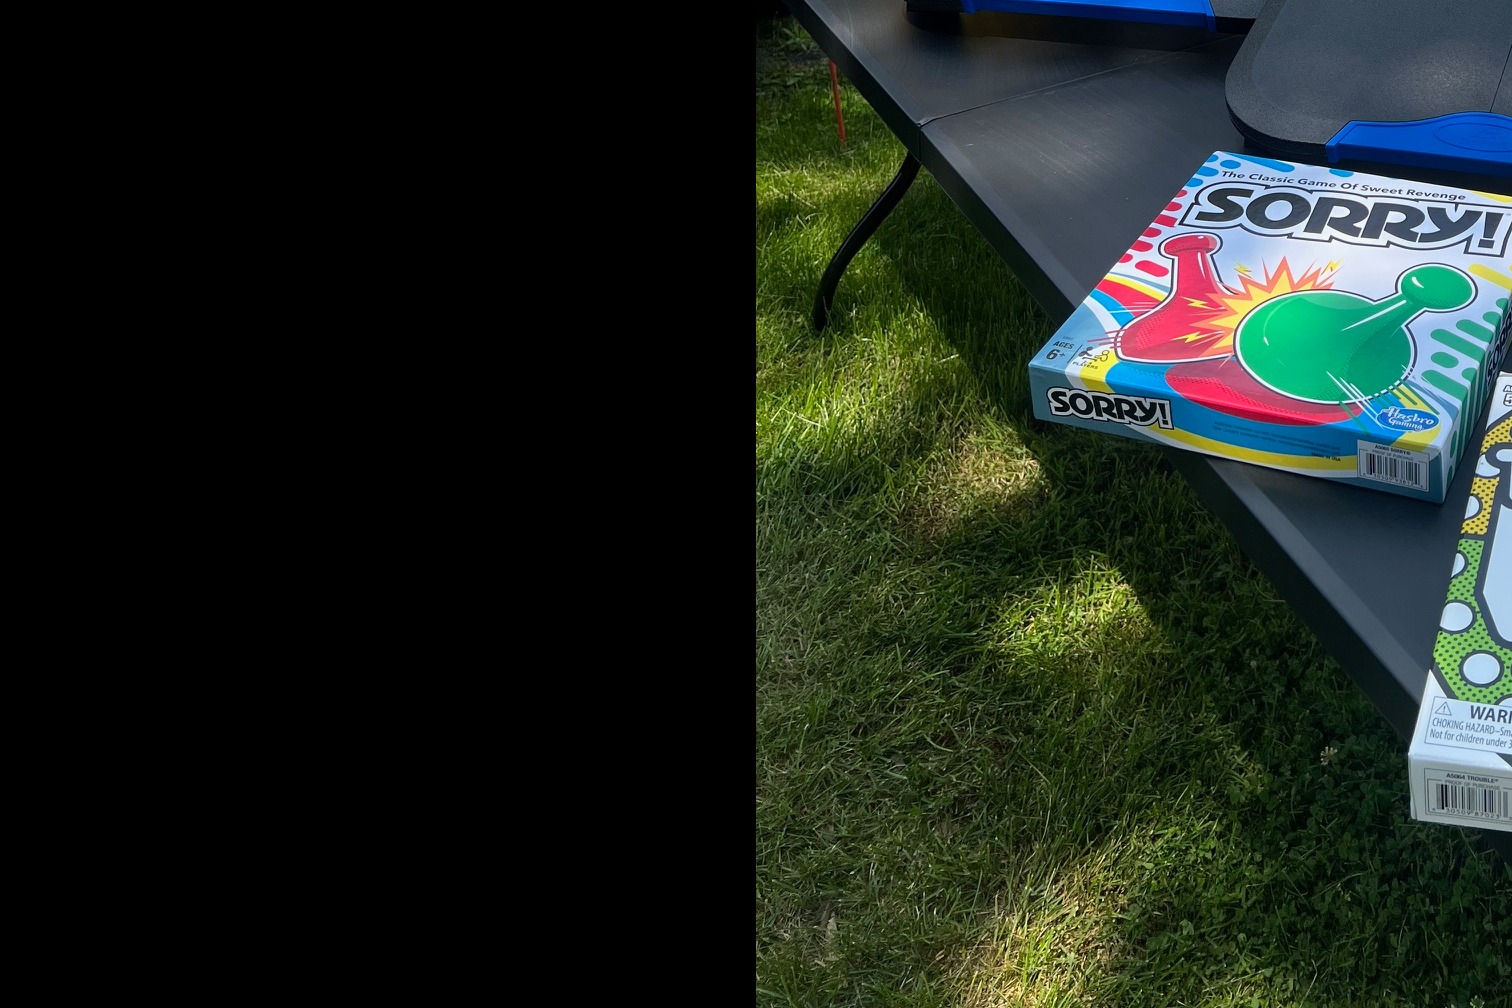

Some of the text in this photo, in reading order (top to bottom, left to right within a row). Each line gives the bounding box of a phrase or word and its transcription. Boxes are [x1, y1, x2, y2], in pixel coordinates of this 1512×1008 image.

[1221, 170, 1466, 201] The Classic Game Of Sweet Revenge
[1195, 187, 1505, 249] SORRY!
[1053, 341, 1074, 350] AGES
[1046, 349, 1065, 360] 6+
[1072, 361, 1098, 370] PLAYERS
[1050, 390, 1169, 425] SORRY!
[1384, 408, 1435, 425] Hasbro
[1388, 417, 1423, 431] Gaming
[1432, 717, 1464, 731] CHOKING
[1429, 730, 1442, 739] Not
[1443, 731, 1454, 740] for
[1455, 733, 1485, 745] children
[1485, 737, 1507, 748] under
[1508, 739, 1512, 749] 3
[1446, 772, 1465, 780] A5064
